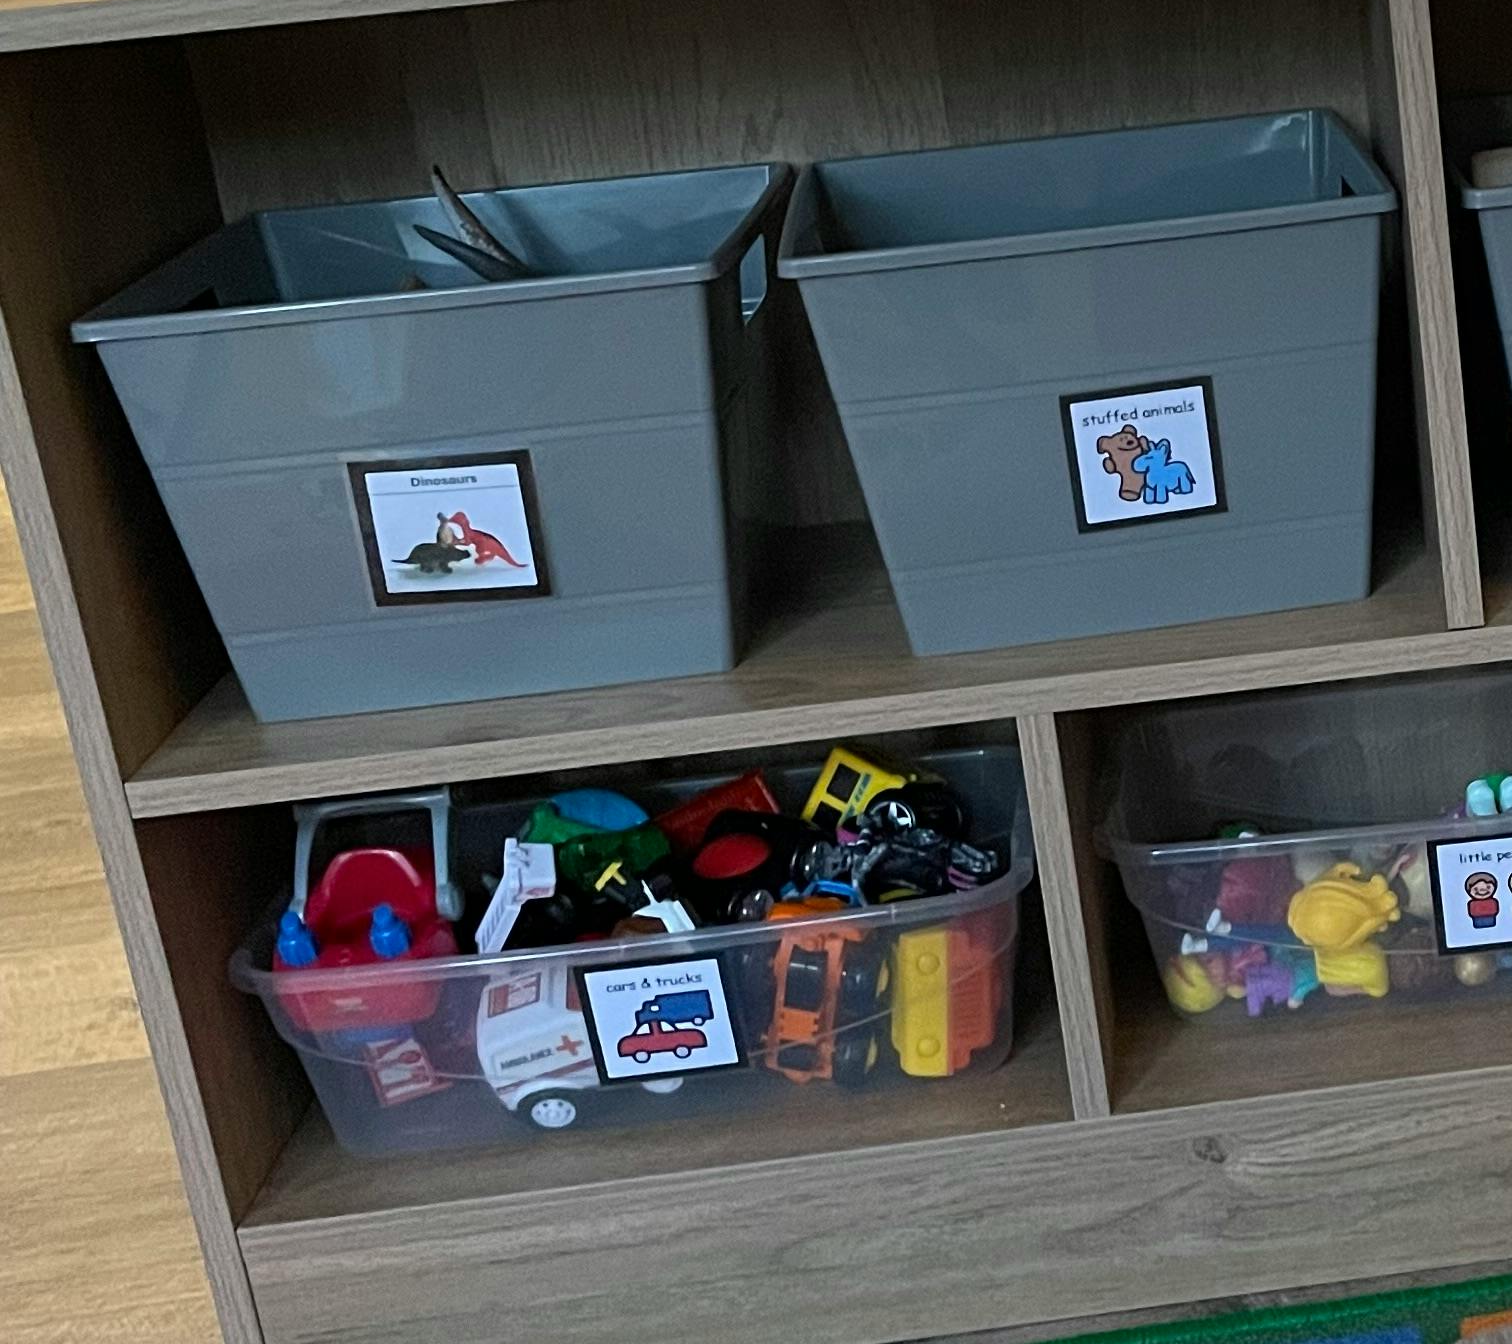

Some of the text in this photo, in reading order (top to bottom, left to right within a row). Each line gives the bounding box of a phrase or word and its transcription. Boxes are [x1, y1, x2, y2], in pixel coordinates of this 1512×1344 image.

[1082, 400, 1195, 427] stuffed animals
[410, 475, 477, 487] Dinosaurs
[1459, 851, 1493, 864] little
[606, 973, 703, 993] cars & trucks
